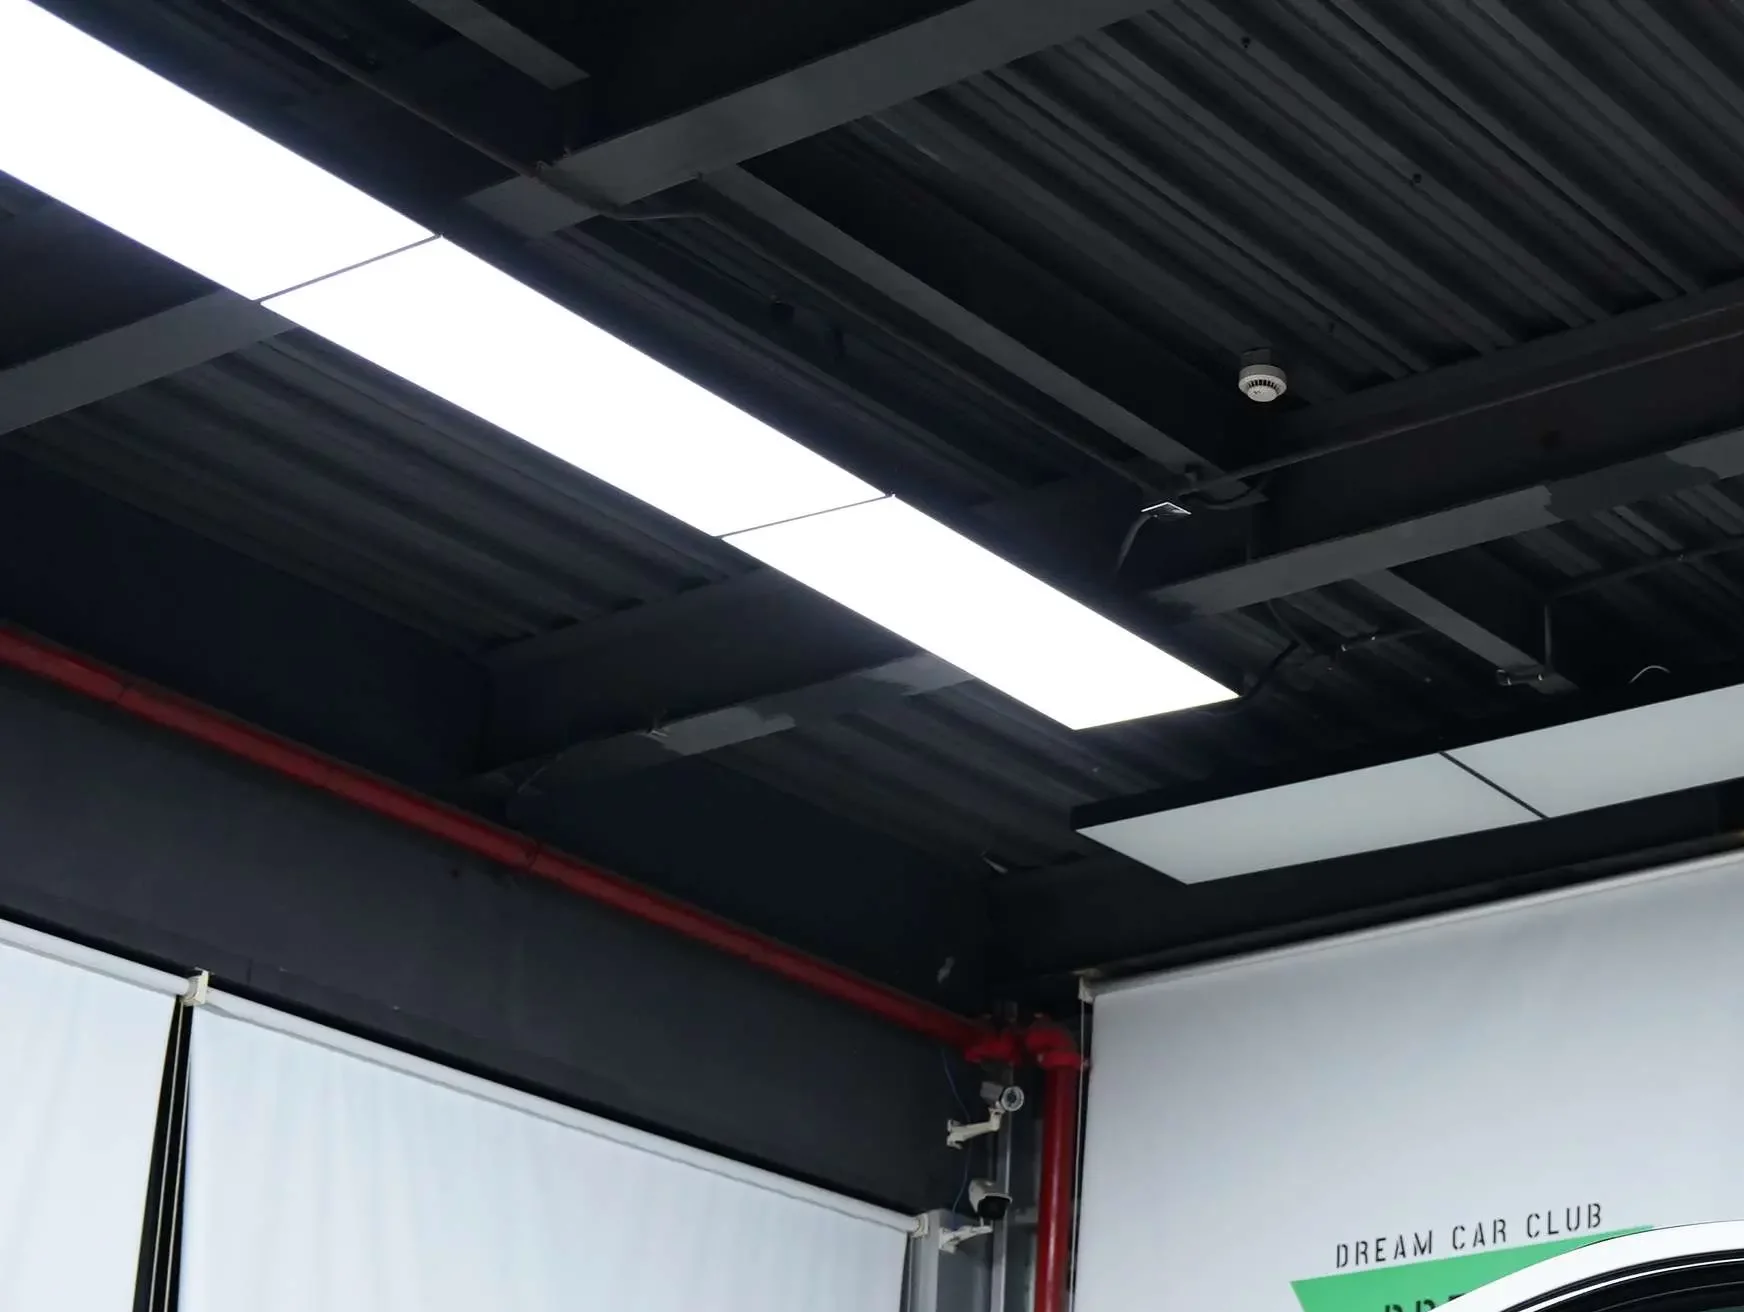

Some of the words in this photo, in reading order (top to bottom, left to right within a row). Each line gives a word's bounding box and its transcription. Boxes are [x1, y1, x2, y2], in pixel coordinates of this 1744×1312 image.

[1335, 1230, 1434, 1269] DREAM
[1451, 1218, 1507, 1251] CAR
[1526, 1202, 1602, 1239] CLUB
